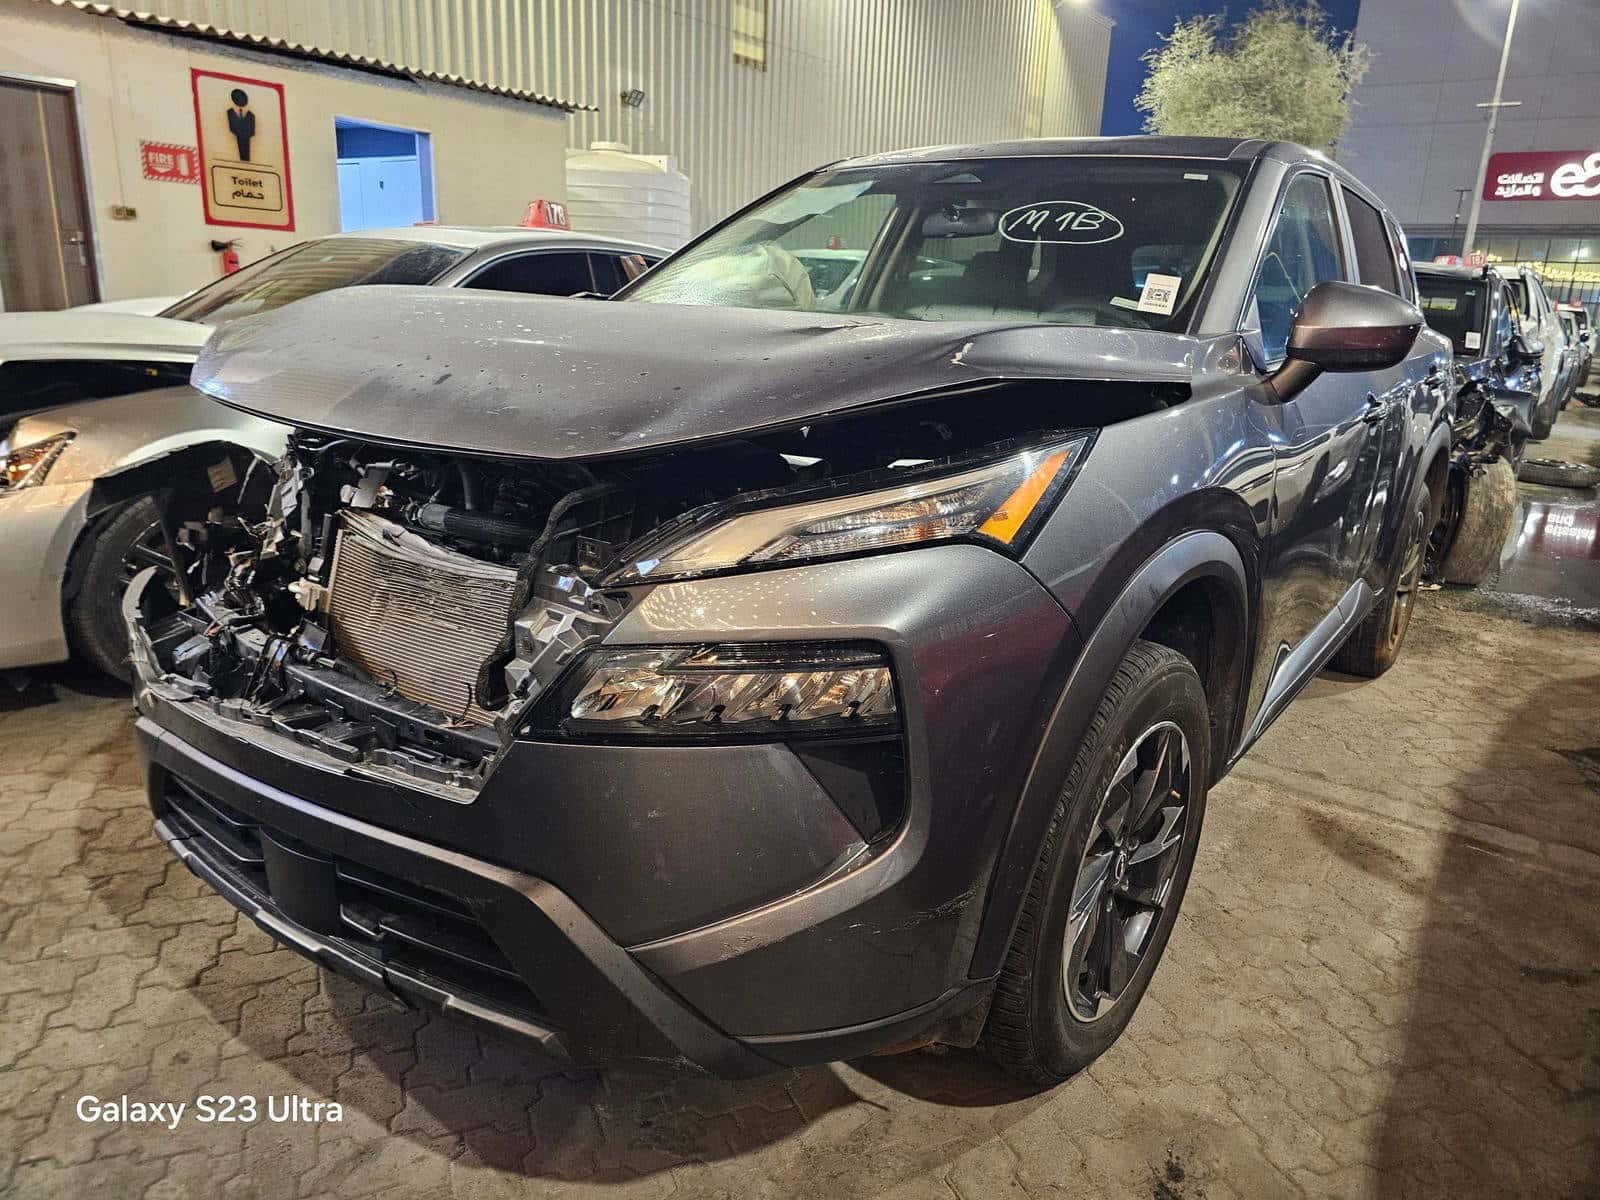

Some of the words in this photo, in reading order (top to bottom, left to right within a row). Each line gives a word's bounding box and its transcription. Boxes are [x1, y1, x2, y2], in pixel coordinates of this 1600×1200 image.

[149, 152, 174, 165] FIRE
[231, 176, 263, 188] Toilet
[232, 189, 264, 200] حمام
[1007, 209, 1050, 232] M
